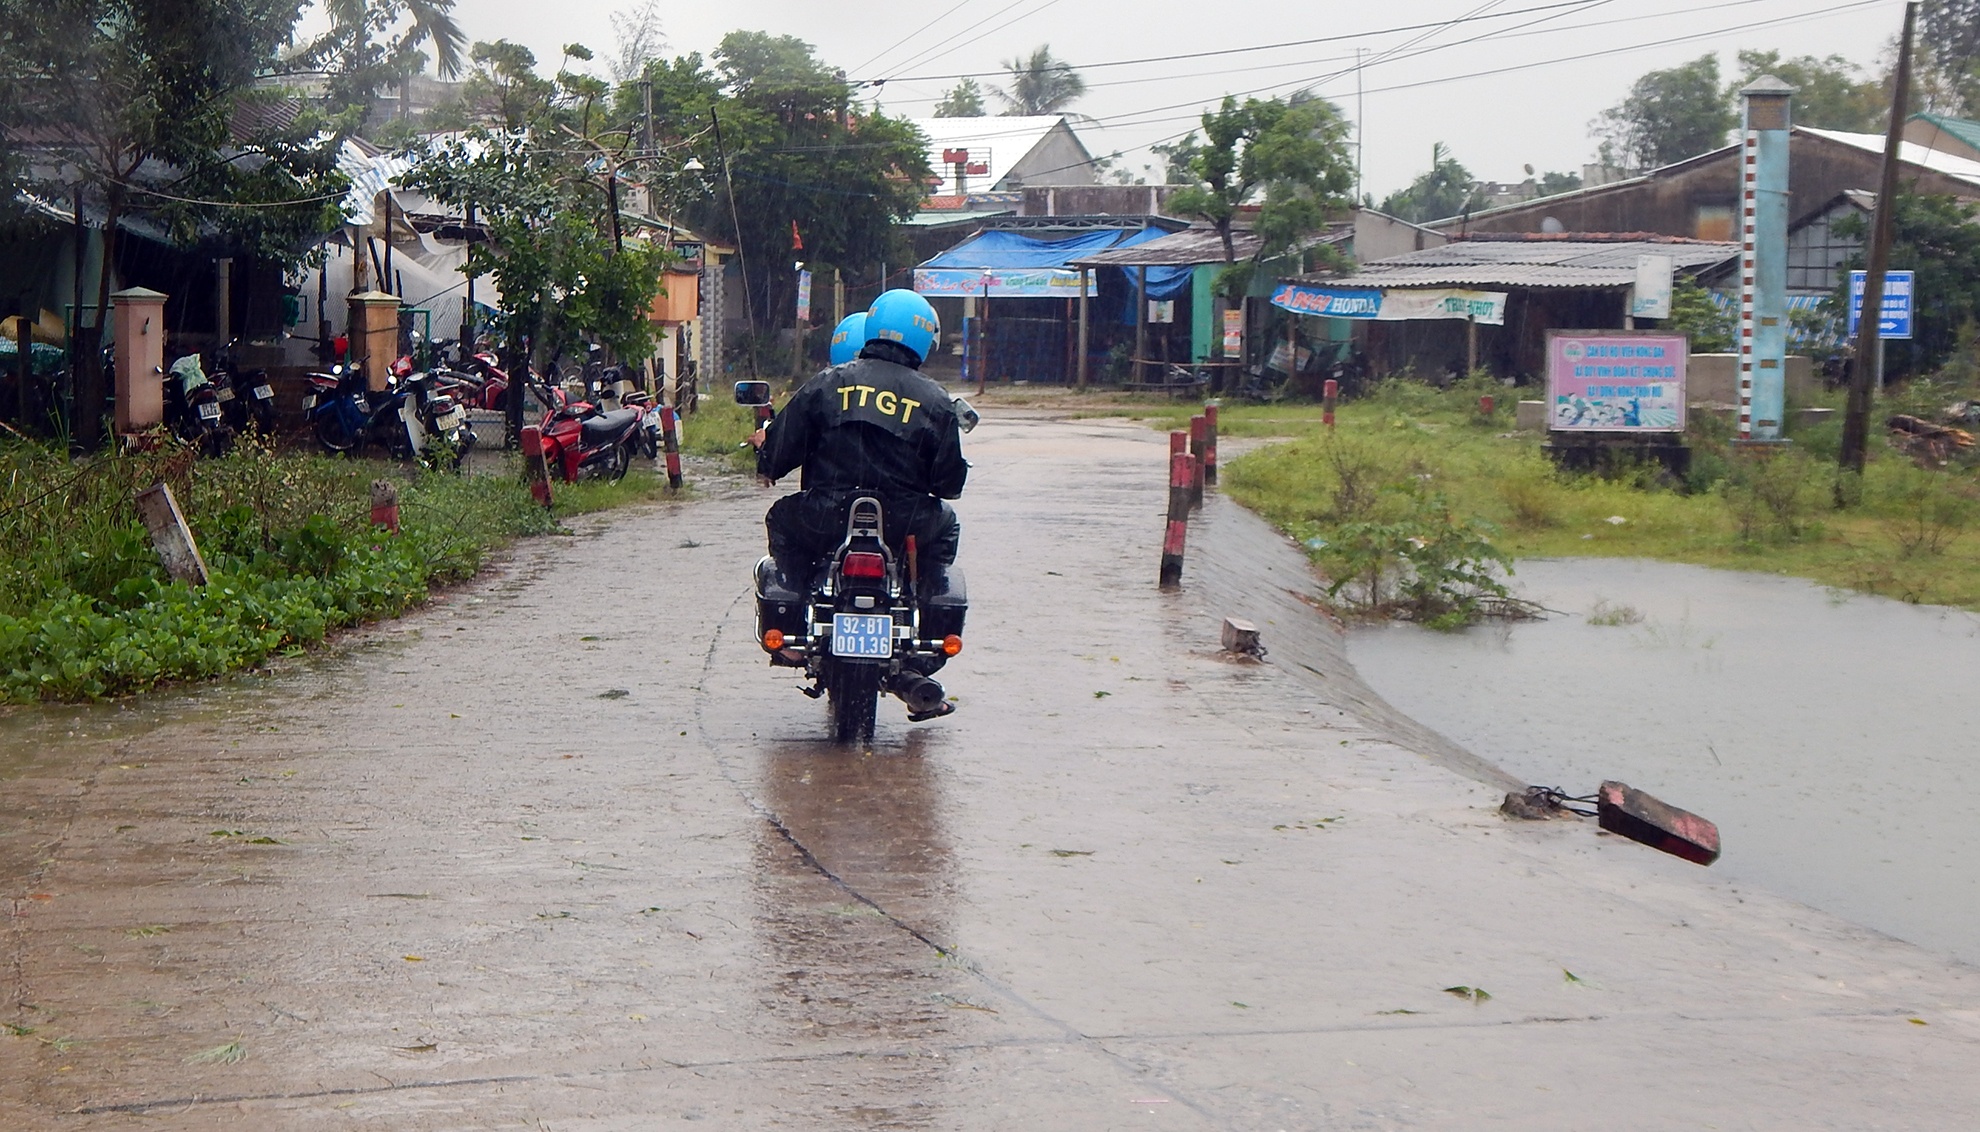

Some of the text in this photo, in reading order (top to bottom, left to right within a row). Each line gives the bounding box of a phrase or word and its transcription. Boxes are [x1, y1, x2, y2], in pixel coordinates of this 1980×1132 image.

[1331, 297, 1378, 314] HONDA
[837, 384, 921, 424] TTGT
[843, 616, 883, 635] 92-B1
[837, 635, 889, 655] 001.36
